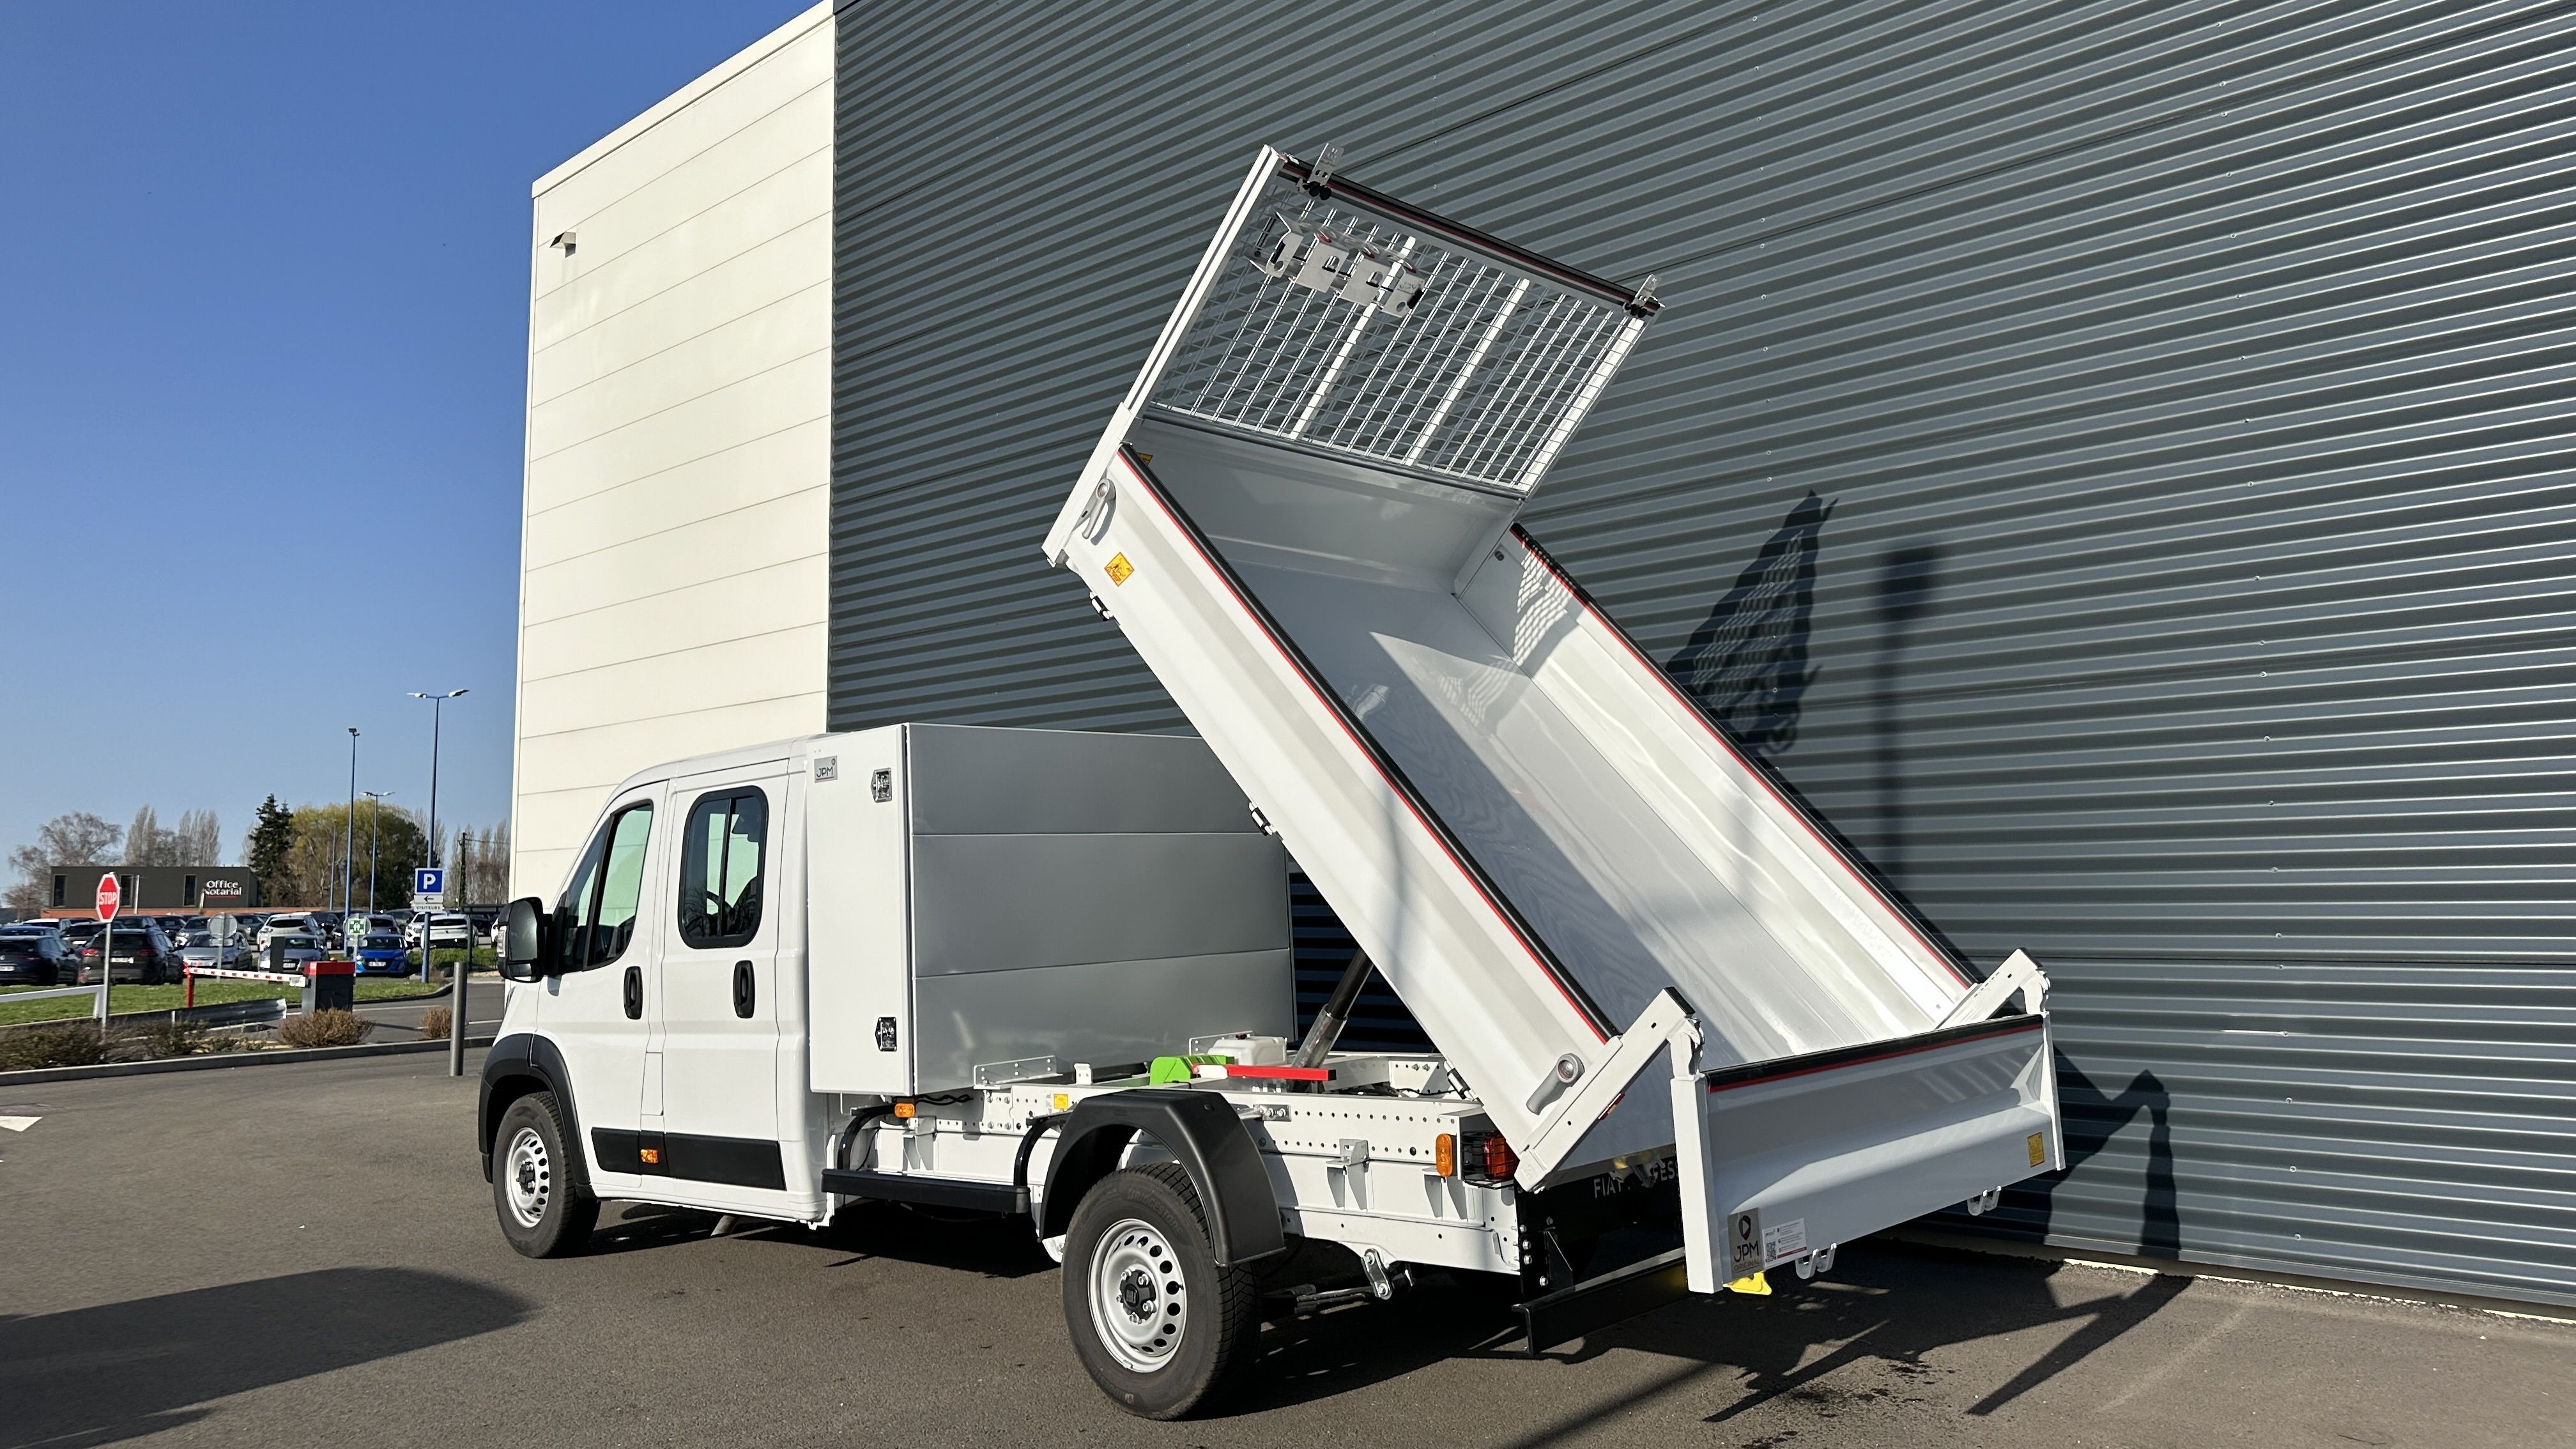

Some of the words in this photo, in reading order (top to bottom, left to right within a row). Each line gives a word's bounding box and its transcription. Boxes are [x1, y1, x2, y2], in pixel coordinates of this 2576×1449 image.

[816, 766, 833, 778] JPM
[206, 880, 238, 889] Office
[423, 873, 436, 890] P
[99, 891, 117, 905] STOP
[204, 887, 242, 896] Notarial
[1593, 1176, 1624, 1199] FIAT
[1733, 1240, 1759, 1262] JPM
[1733, 1258, 1761, 1272] ORIGINAL
